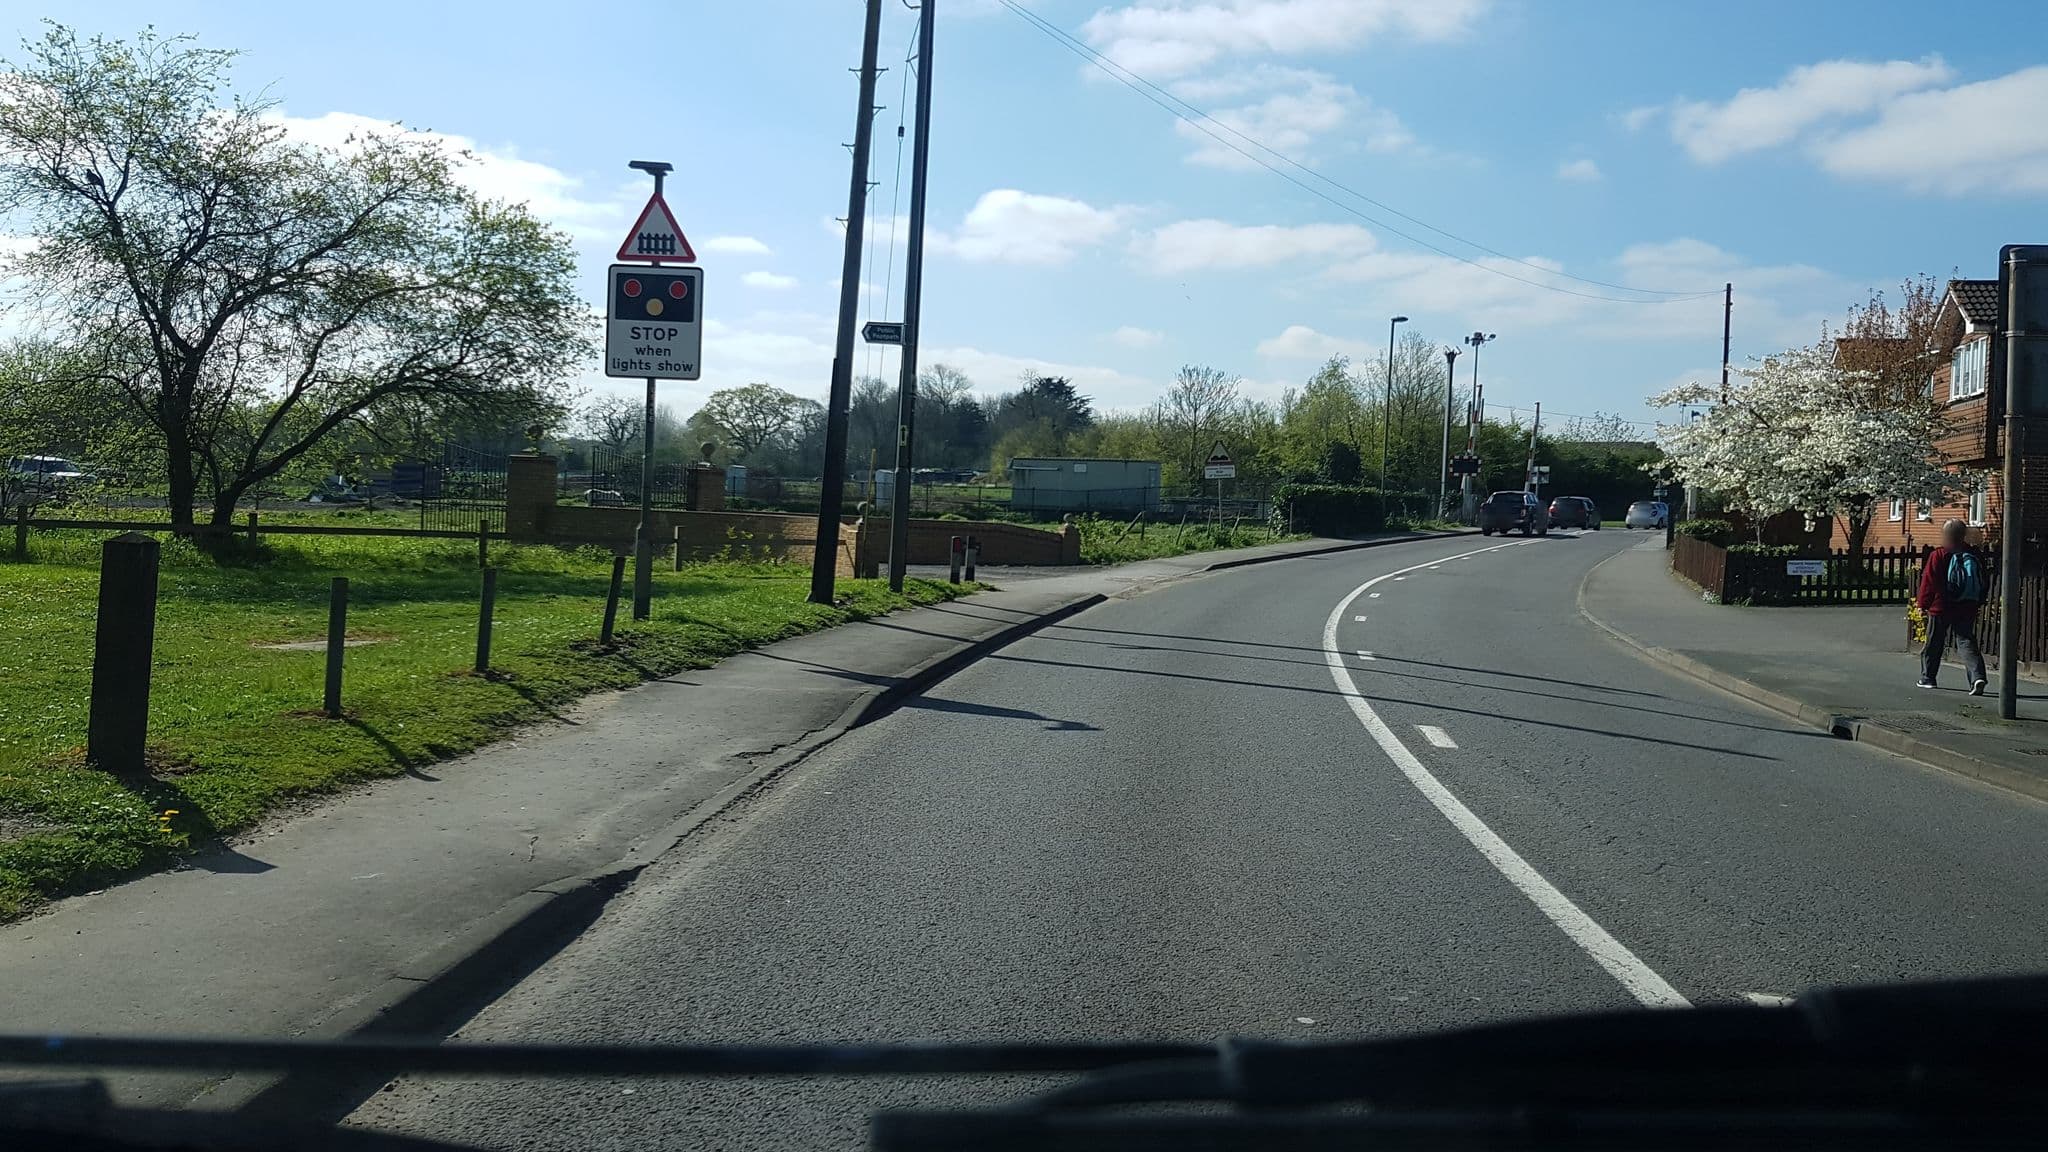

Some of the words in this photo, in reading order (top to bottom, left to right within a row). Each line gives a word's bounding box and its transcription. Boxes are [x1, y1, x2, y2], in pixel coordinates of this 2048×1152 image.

[630, 326, 678, 341] STOP
[635, 345, 671, 357] when
[612, 358, 651, 372] lights
[657, 360, 693, 372] show
